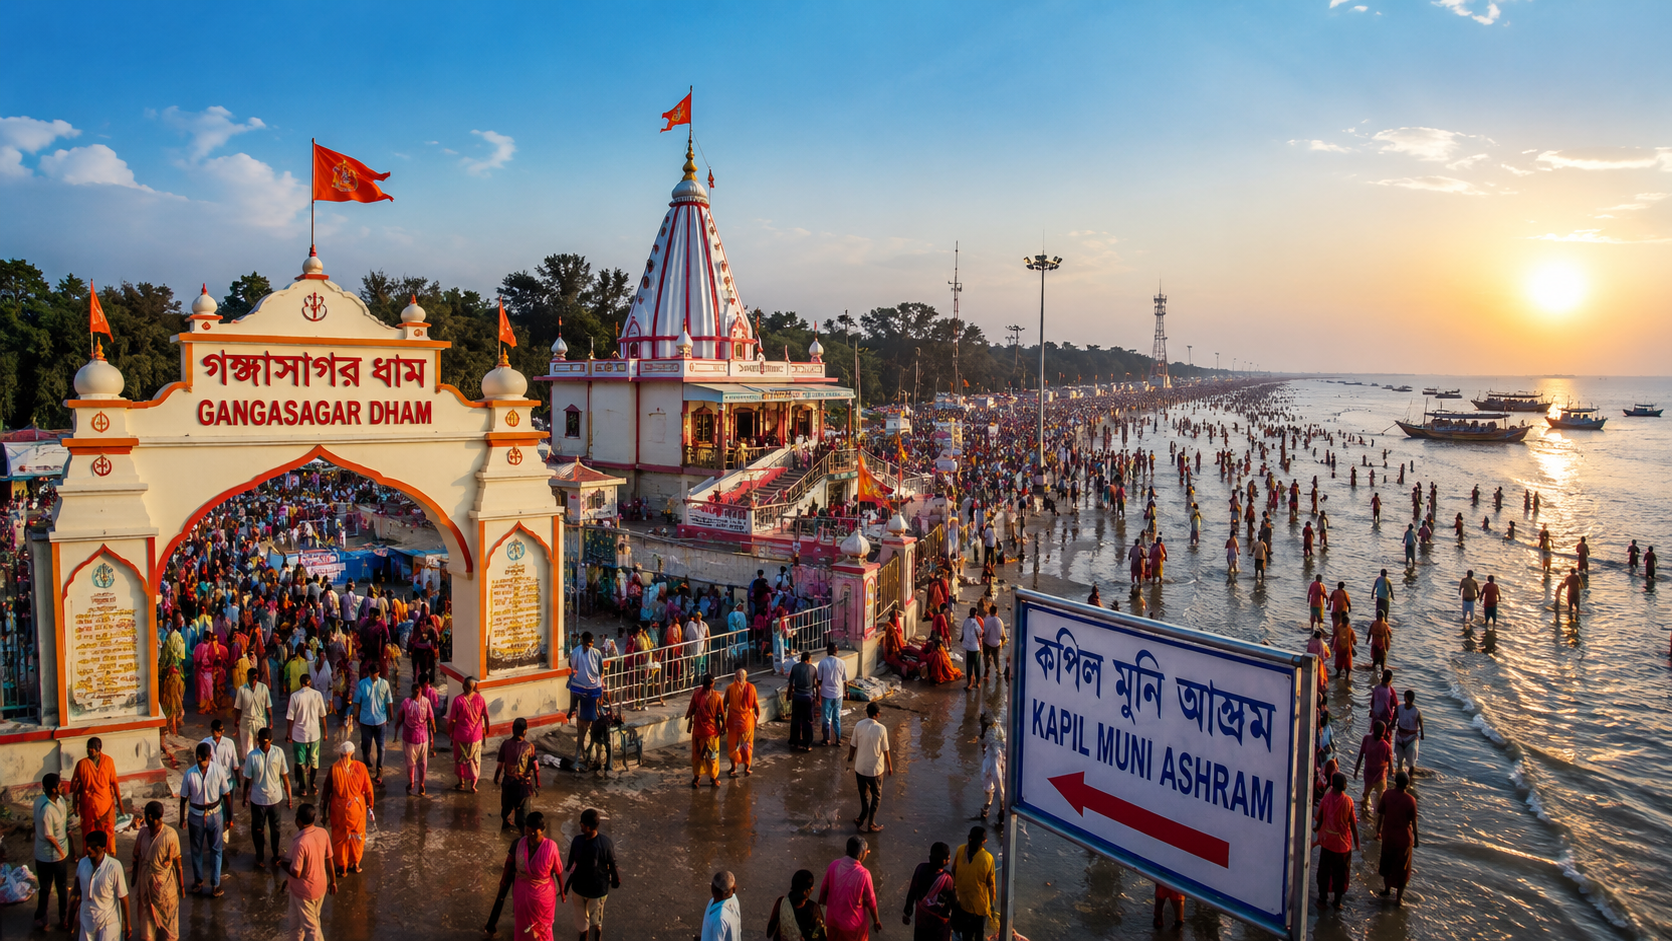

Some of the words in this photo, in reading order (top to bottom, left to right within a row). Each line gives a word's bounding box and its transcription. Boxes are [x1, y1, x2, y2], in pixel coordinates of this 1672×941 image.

[203, 350, 362, 387] গঙ্গাসাগর
[372, 354, 427, 388] ধাম
[198, 399, 362, 426] GANGASAGAR
[369, 400, 432, 425] DHAM
[1034, 627, 1104, 699] কপিল
[1113, 649, 1165, 725] মুনি
[1032, 698, 1090, 757] KAPIL
[1097, 722, 1152, 781] MUNI
[1159, 746, 1274, 824] ASHRAM
